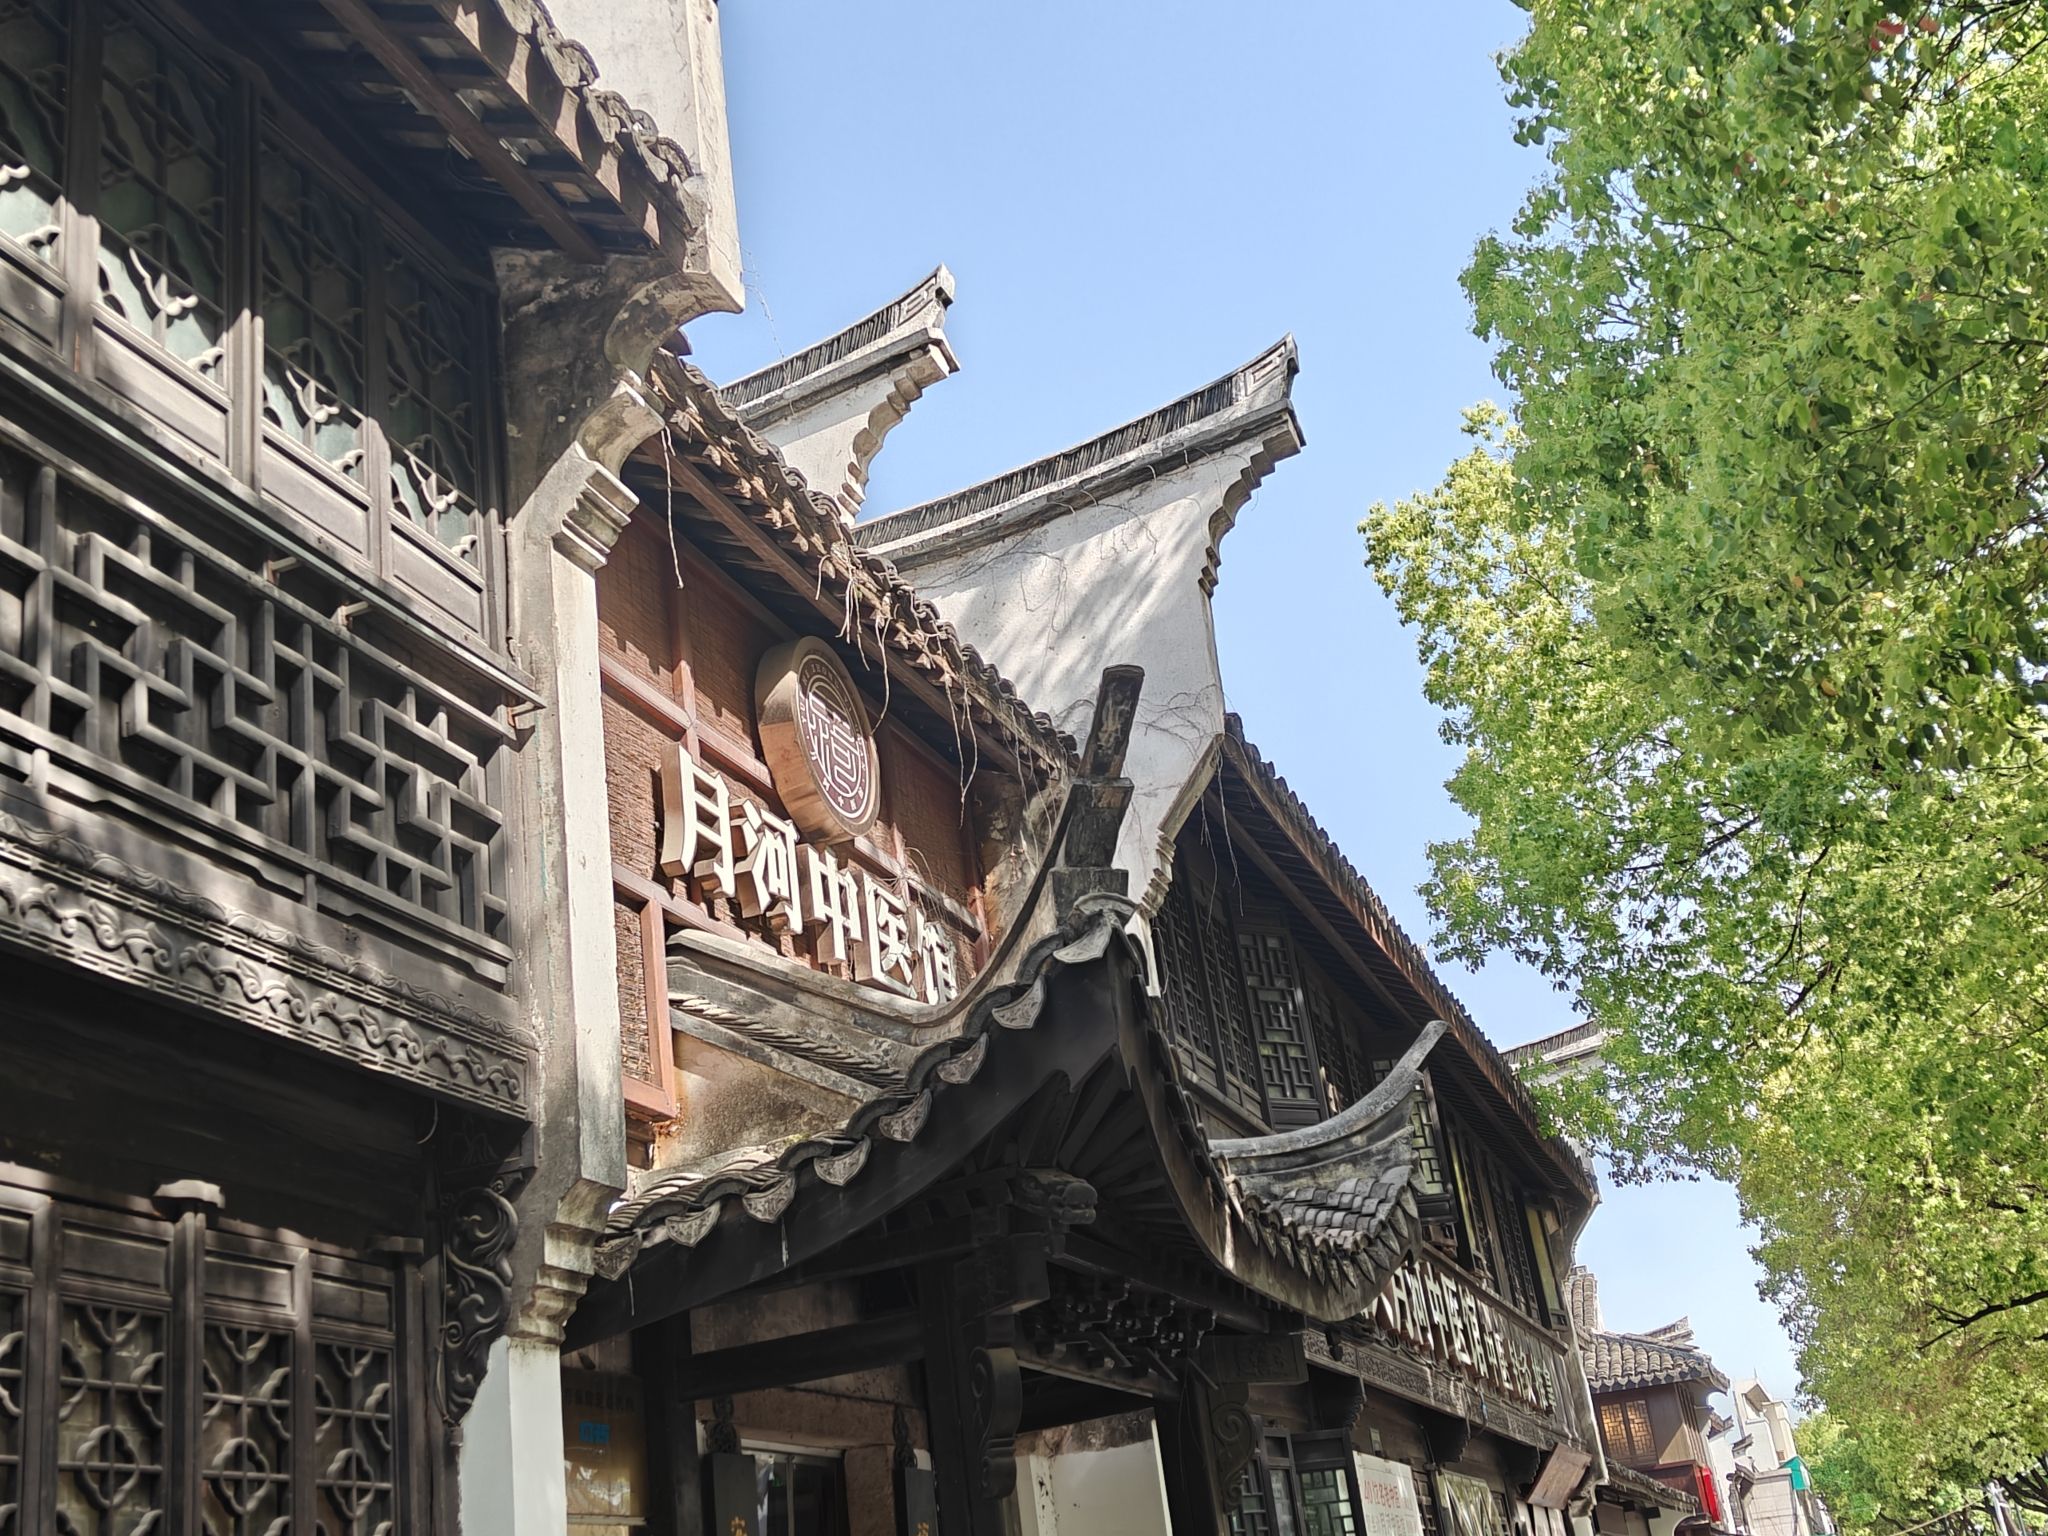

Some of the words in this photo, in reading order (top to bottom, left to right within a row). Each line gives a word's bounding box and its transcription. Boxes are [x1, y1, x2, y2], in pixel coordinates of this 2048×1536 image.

[677, 744, 959, 1005] 月河中医馆
